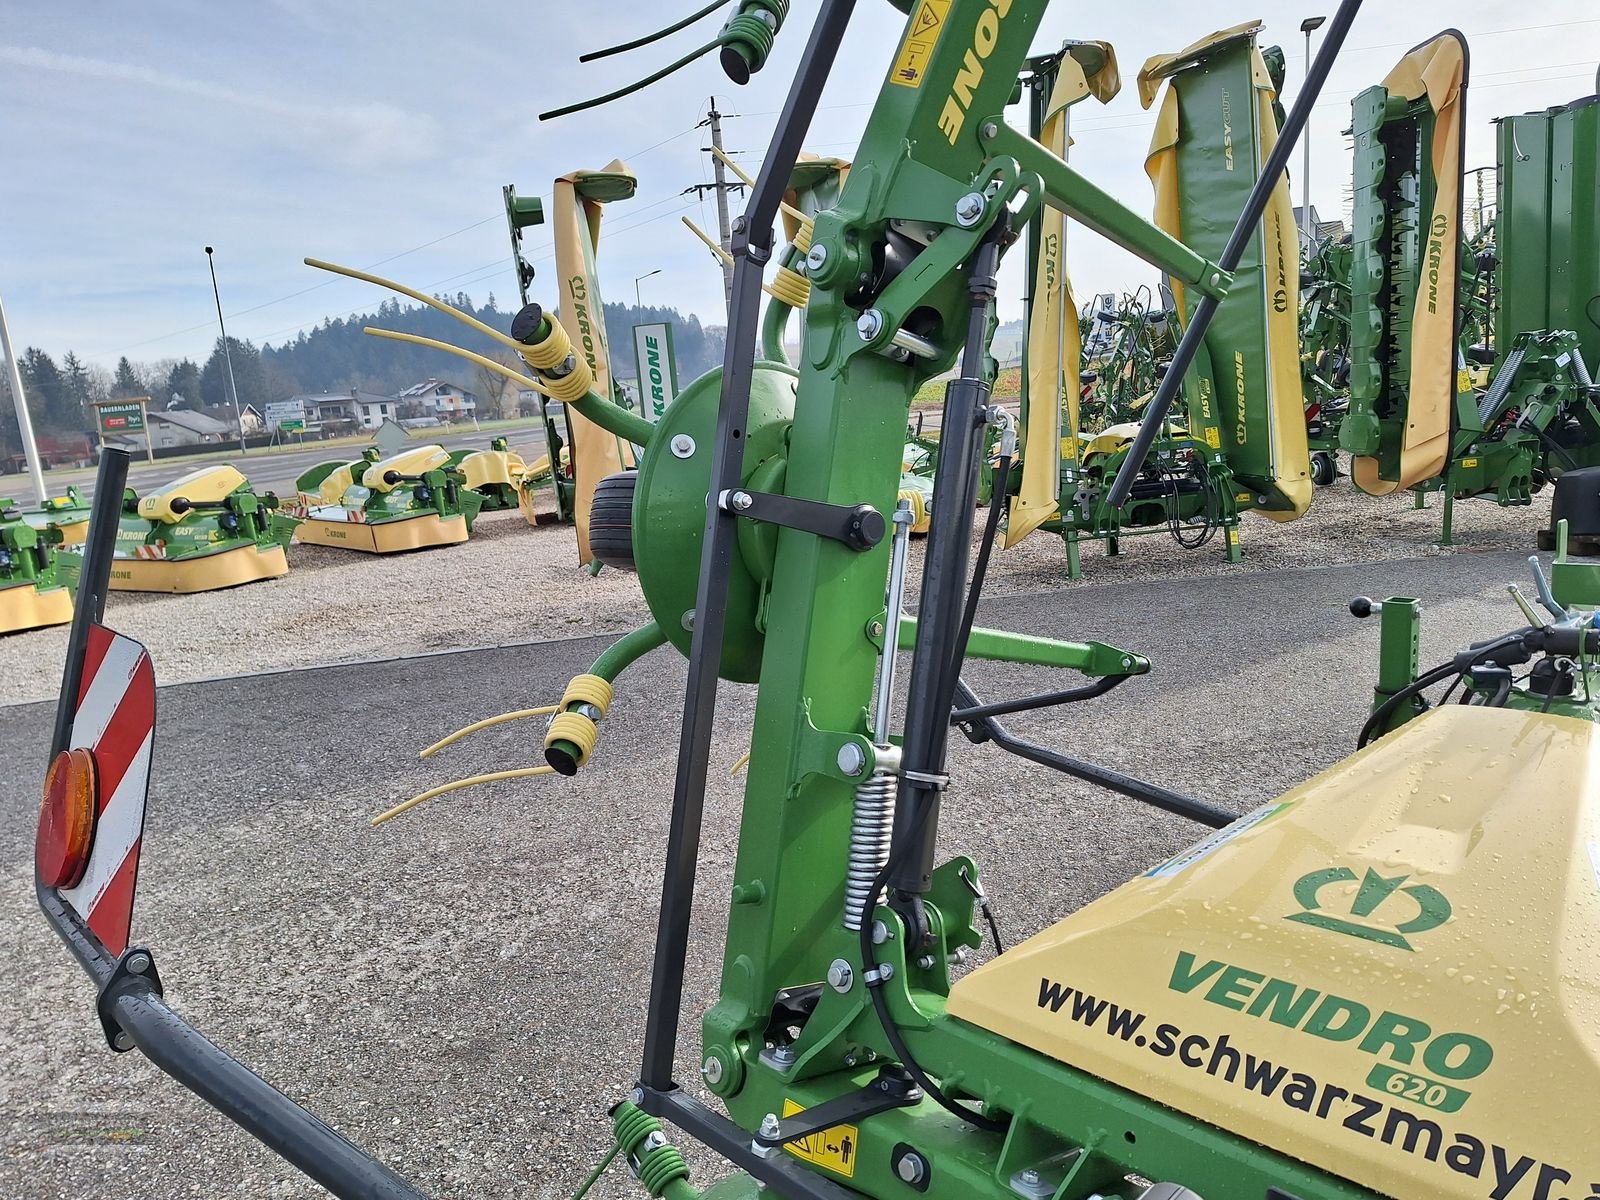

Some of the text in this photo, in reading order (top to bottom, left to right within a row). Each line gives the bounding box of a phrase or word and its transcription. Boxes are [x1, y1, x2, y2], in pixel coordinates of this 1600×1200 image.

[1428, 239, 1442, 315] KRONE
[573, 303, 598, 382] KRONE
[645, 335, 665, 418] KRONE
[100, 403, 141, 414] BAUERNLADEN
[1234, 350, 1246, 423] KRONE
[110, 571, 132, 579] RONE
[1168, 950, 1494, 1080] VENDRO
[1037, 977, 1600, 1200] www.schwarzmayr
[1385, 1072, 1448, 1107] 620
